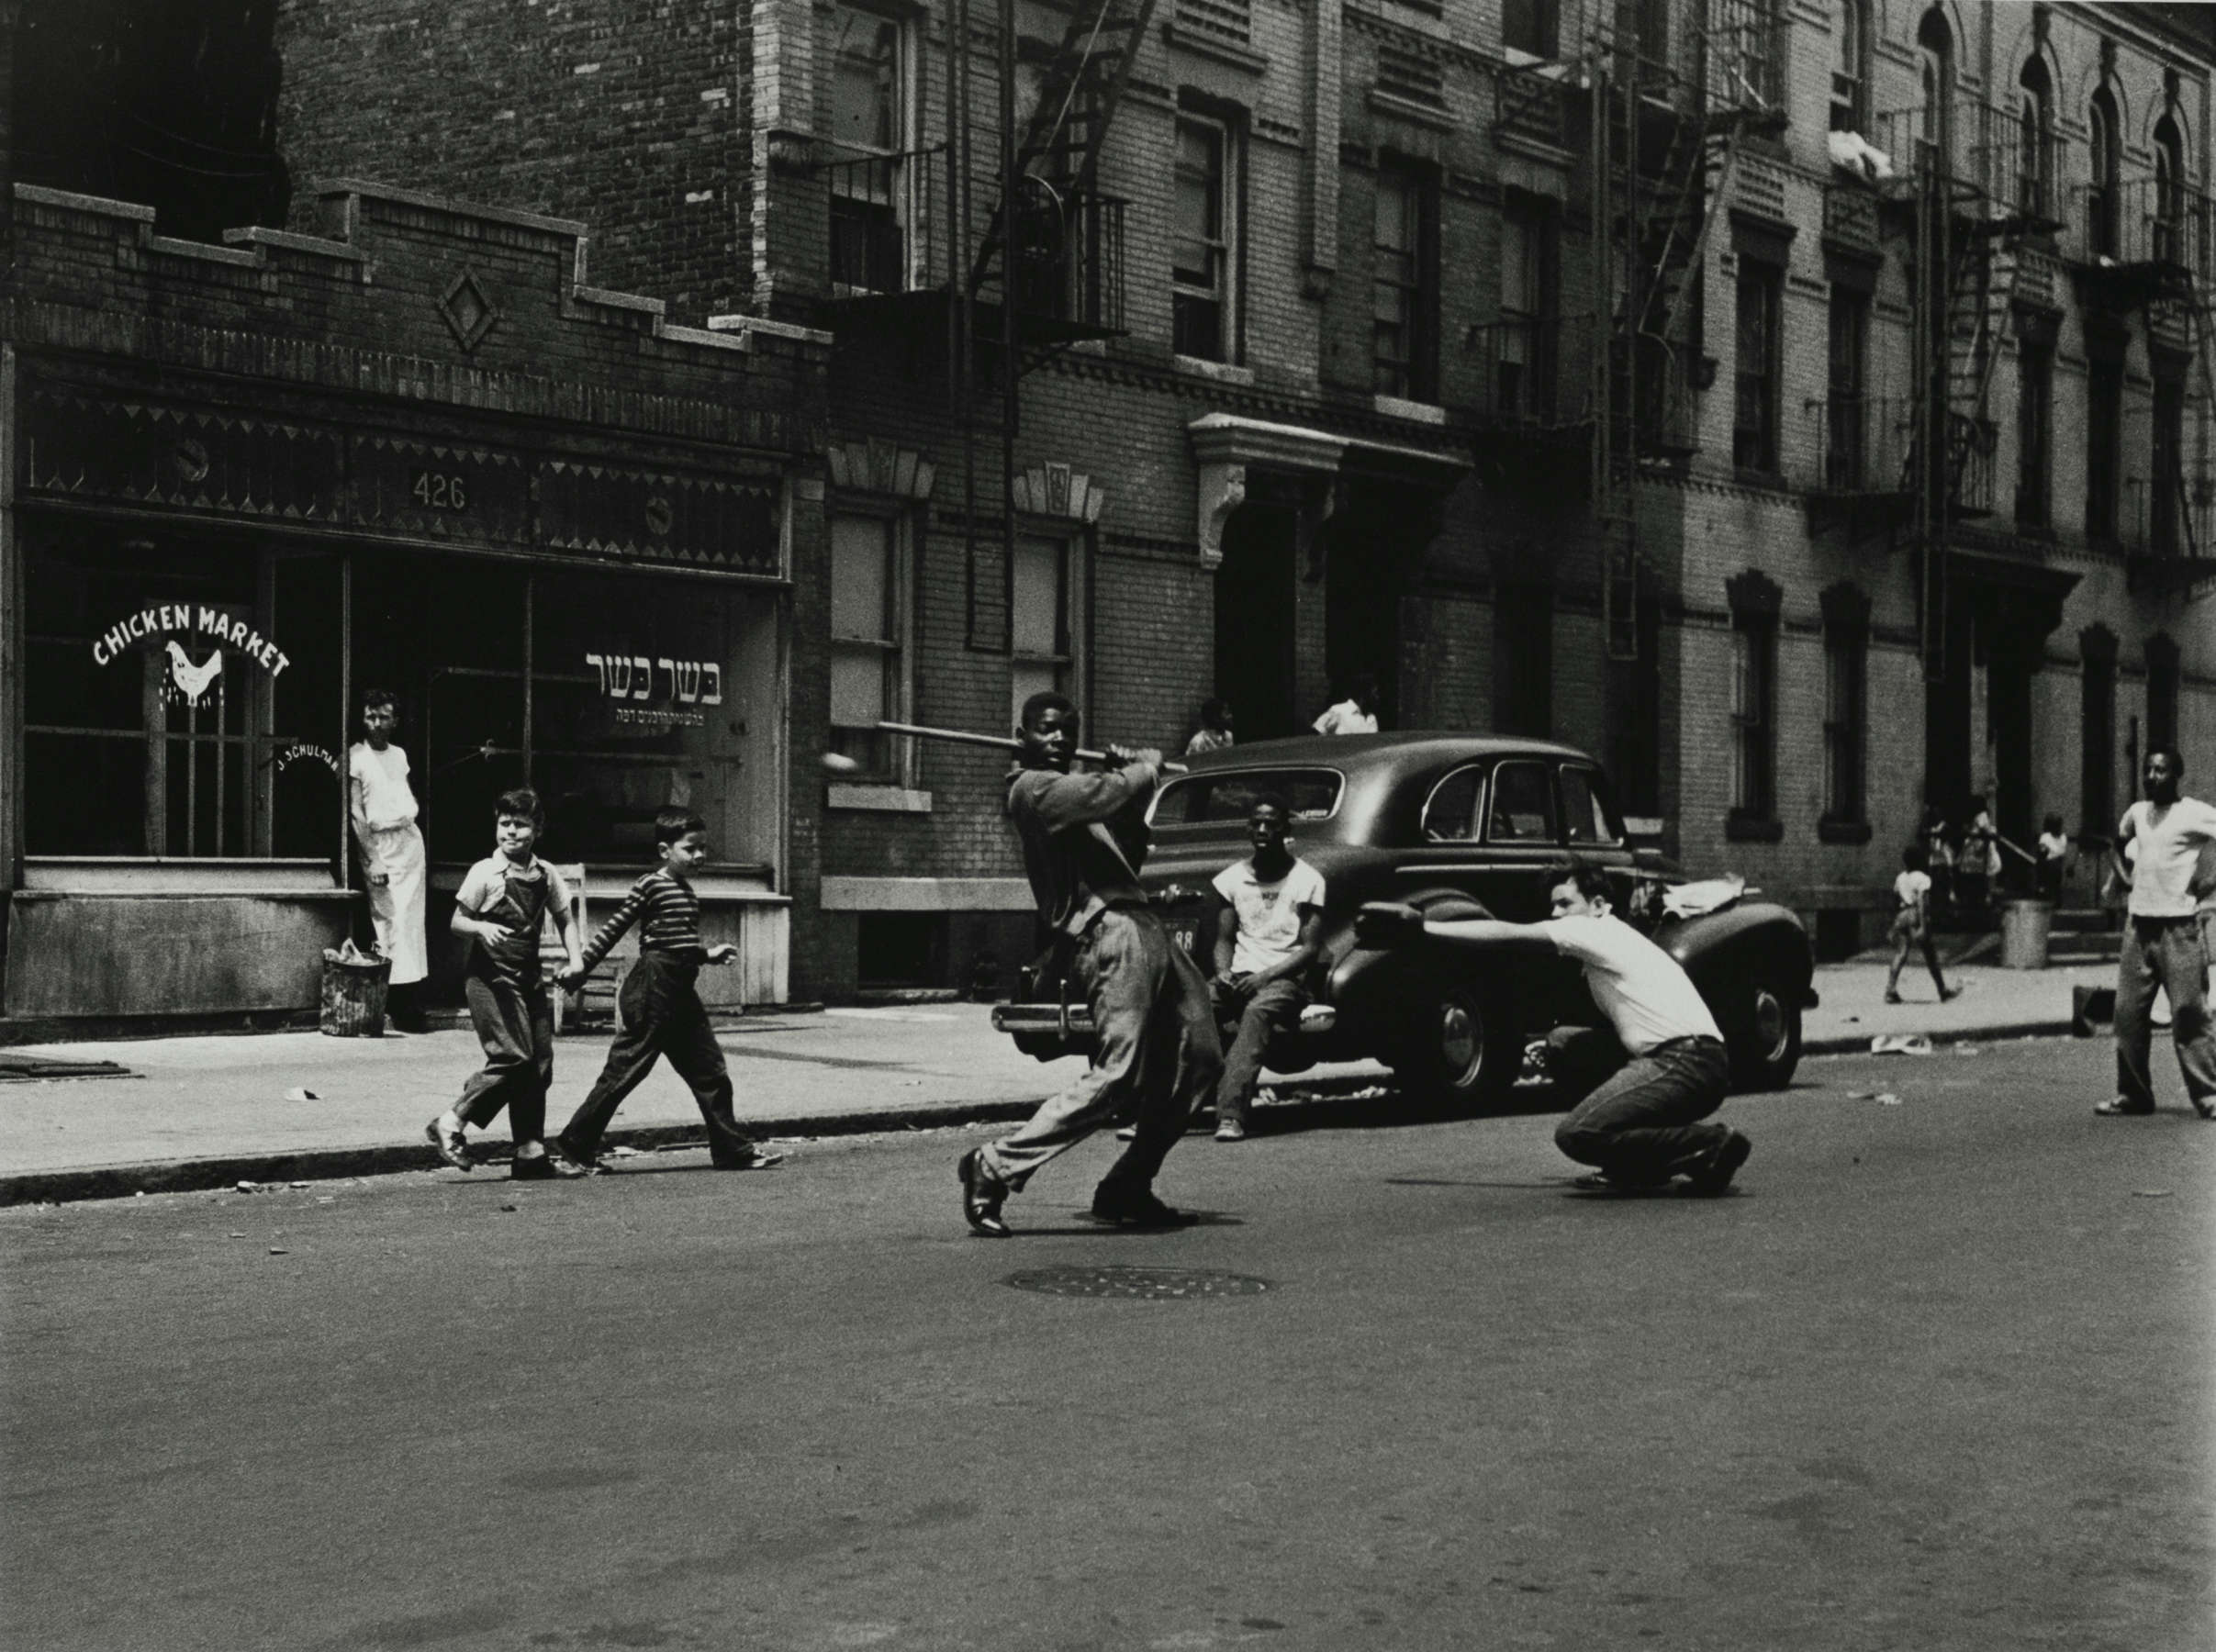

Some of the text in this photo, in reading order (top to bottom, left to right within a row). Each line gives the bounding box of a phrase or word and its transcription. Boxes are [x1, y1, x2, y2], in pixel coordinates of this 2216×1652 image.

[414, 472, 464, 508] 426
[93, 604, 290, 677] CHICKEN MARKET
